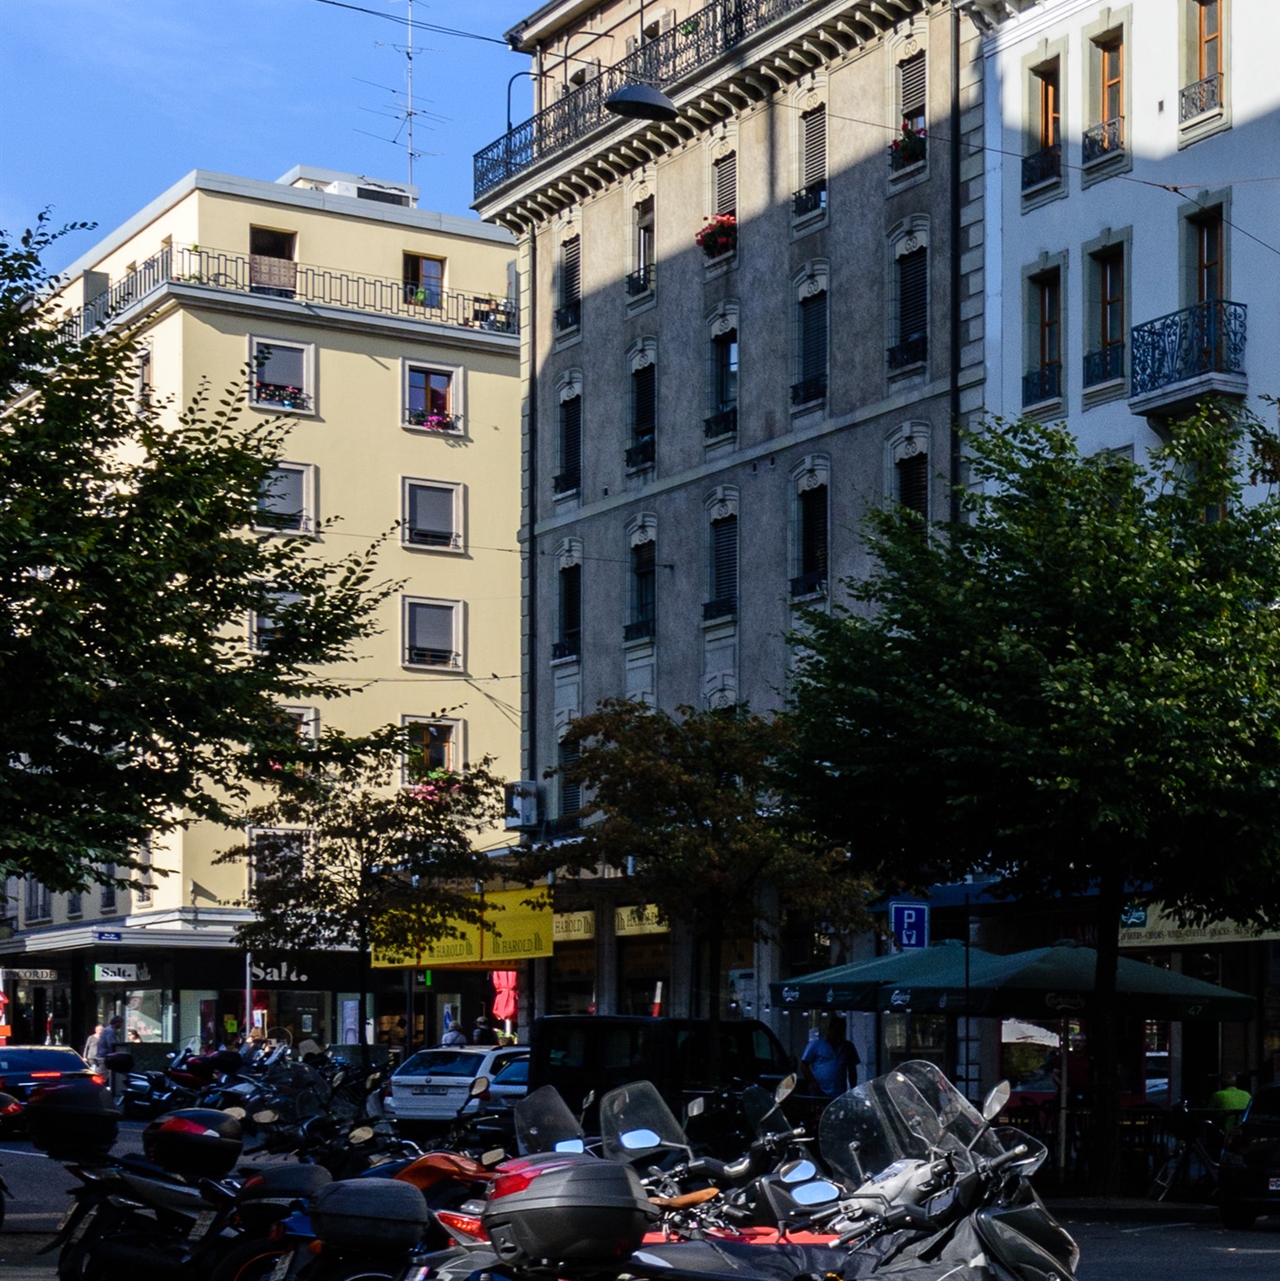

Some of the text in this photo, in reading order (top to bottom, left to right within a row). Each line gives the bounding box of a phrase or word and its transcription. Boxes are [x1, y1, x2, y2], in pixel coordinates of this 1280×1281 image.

[555, 919, 582, 933] HAROLD
[904, 910, 916, 929] P
[502, 937, 532, 952] HAROLD
[101, 967, 131, 978] Salt.
[252, 961, 308, 982] Salt.
